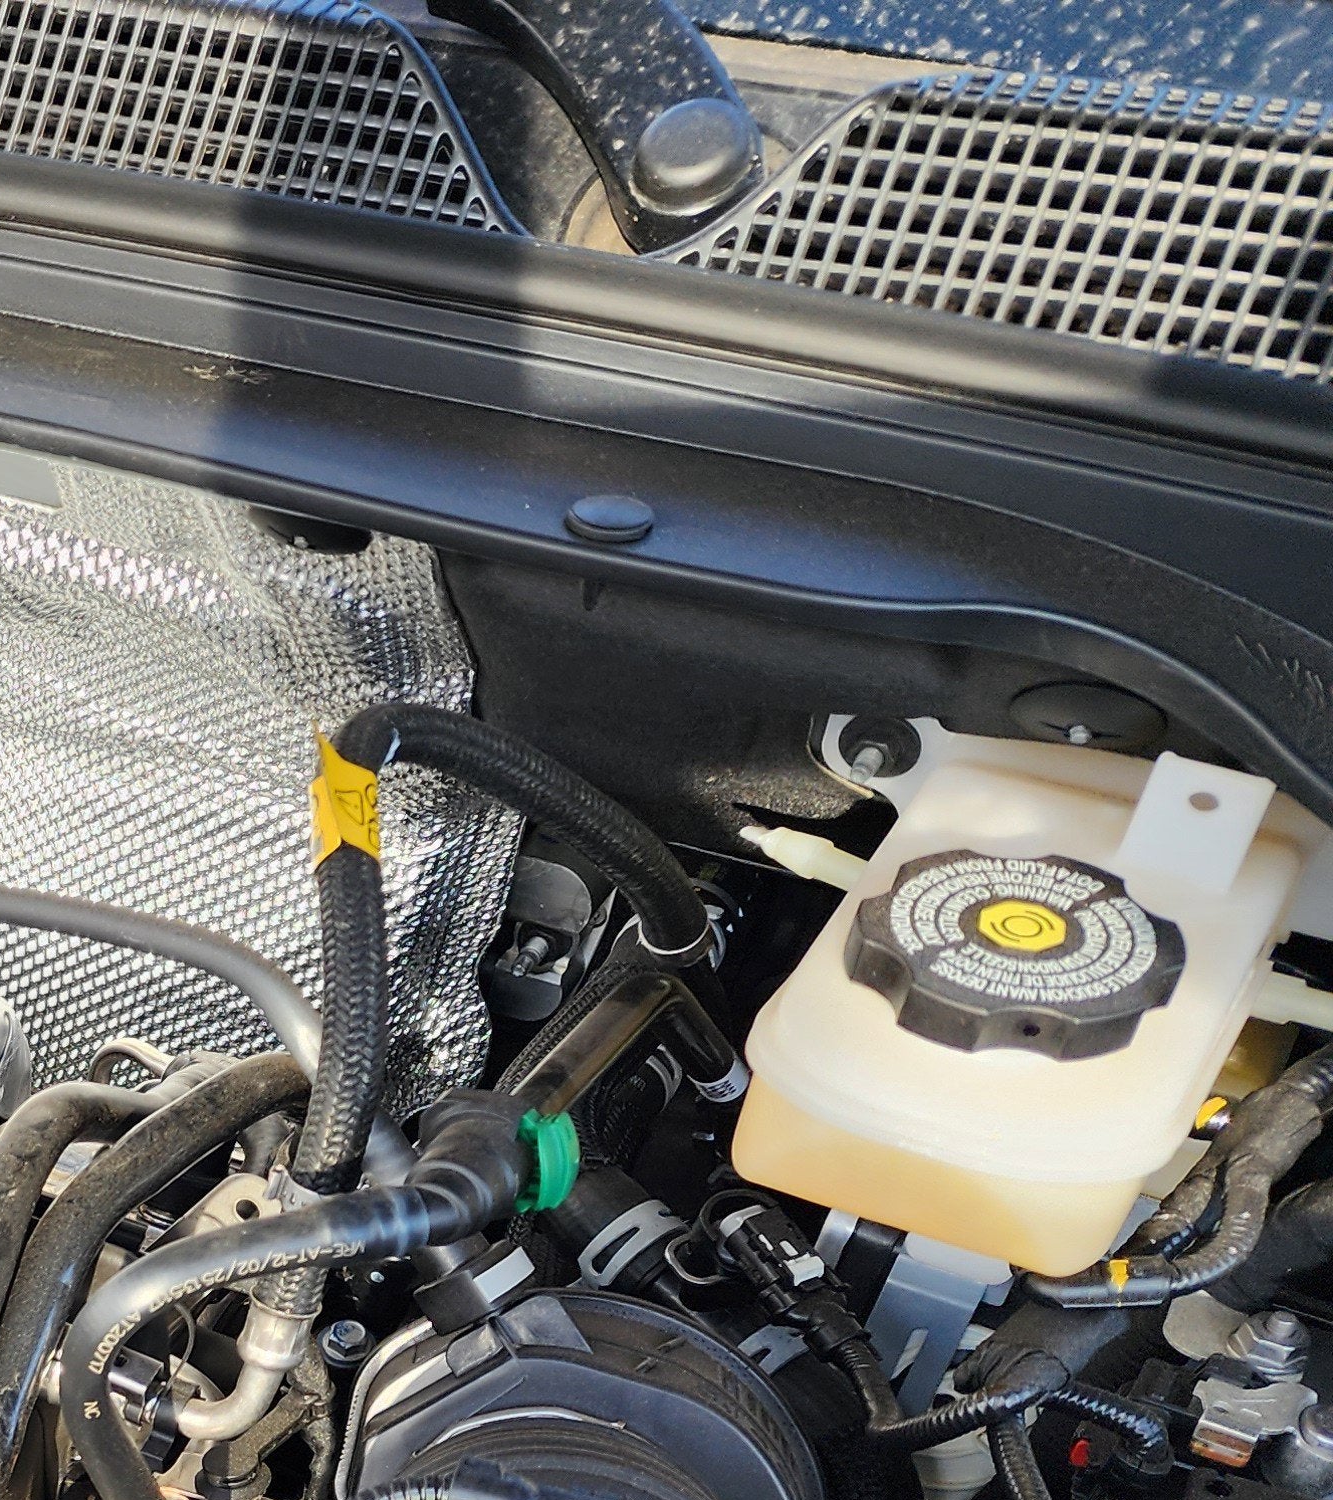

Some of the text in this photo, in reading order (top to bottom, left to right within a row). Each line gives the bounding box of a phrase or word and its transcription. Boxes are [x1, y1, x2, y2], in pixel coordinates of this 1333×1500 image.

[948, 858, 1005, 875] FROM
[1001, 858, 1058, 879] FLUID
[984, 871, 1055, 890] BEFORE
[983, 979, 1040, 1001] AVANT
